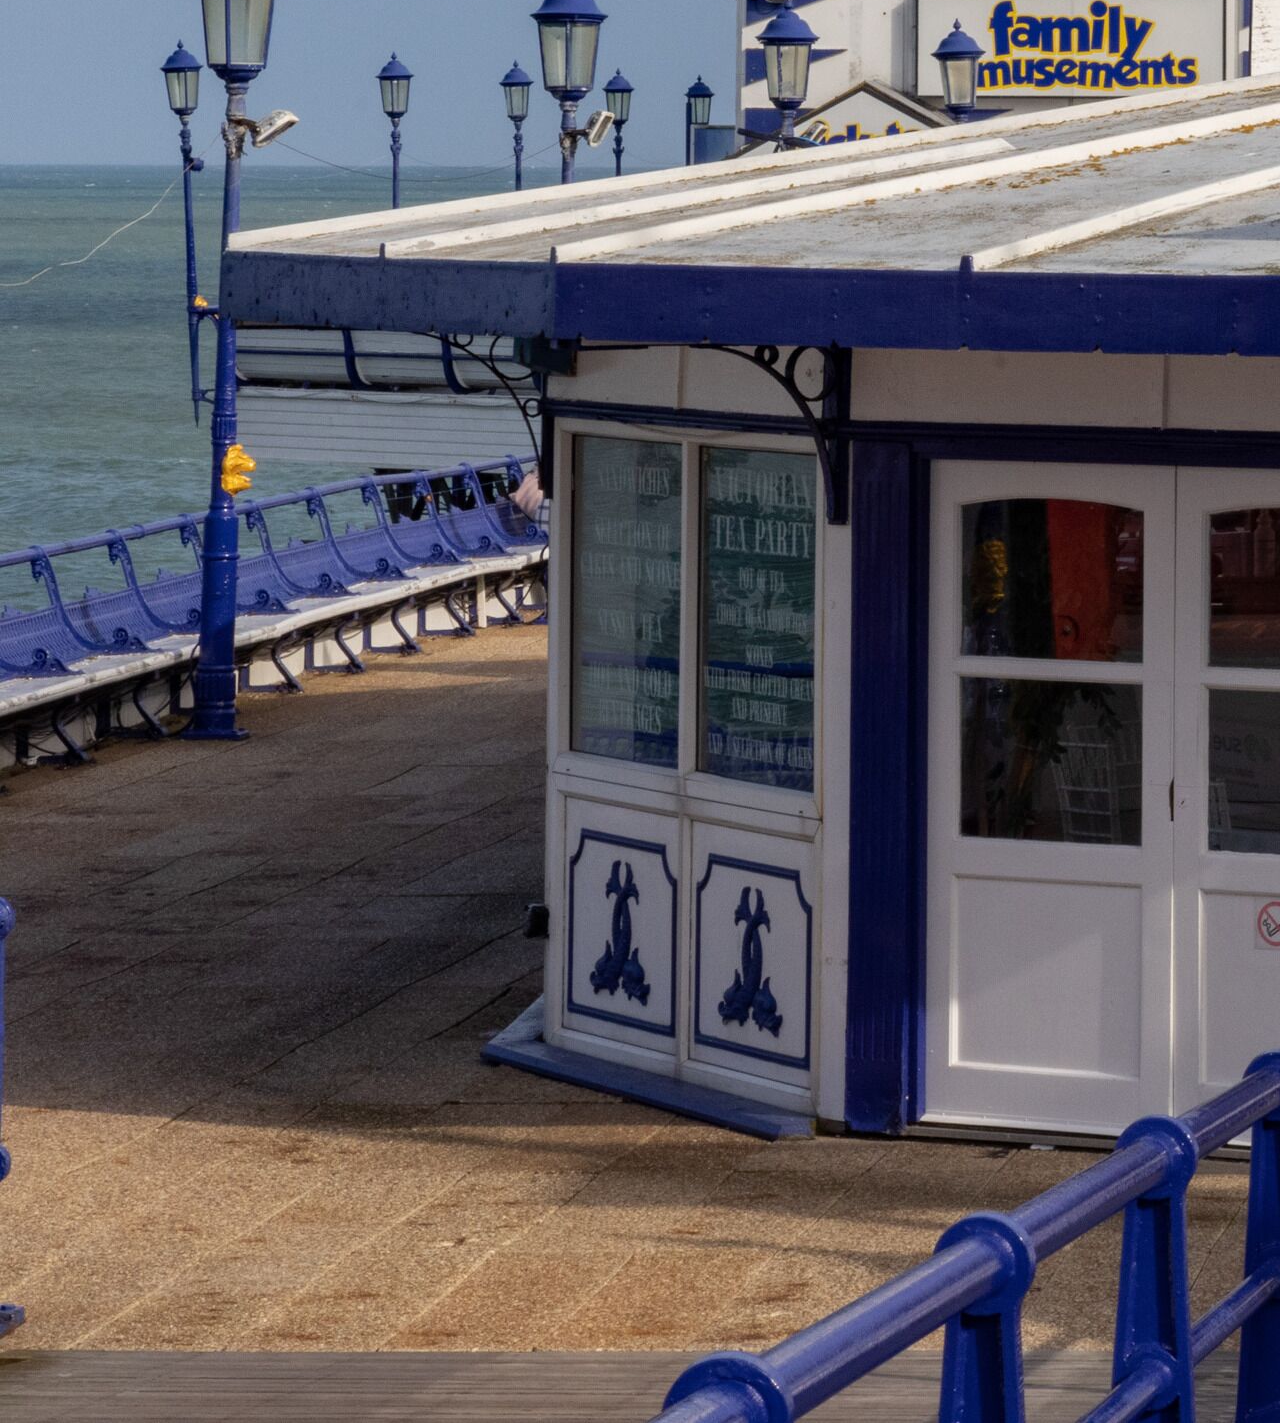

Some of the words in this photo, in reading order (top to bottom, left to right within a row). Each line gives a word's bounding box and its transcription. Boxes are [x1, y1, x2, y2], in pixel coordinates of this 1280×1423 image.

[988, 0, 1155, 60] family
[976, 52, 1200, 90] musements
[714, 466, 813, 509] VICTORIAN
[712, 514, 750, 552] TEA
[754, 518, 813, 558] PARTY
